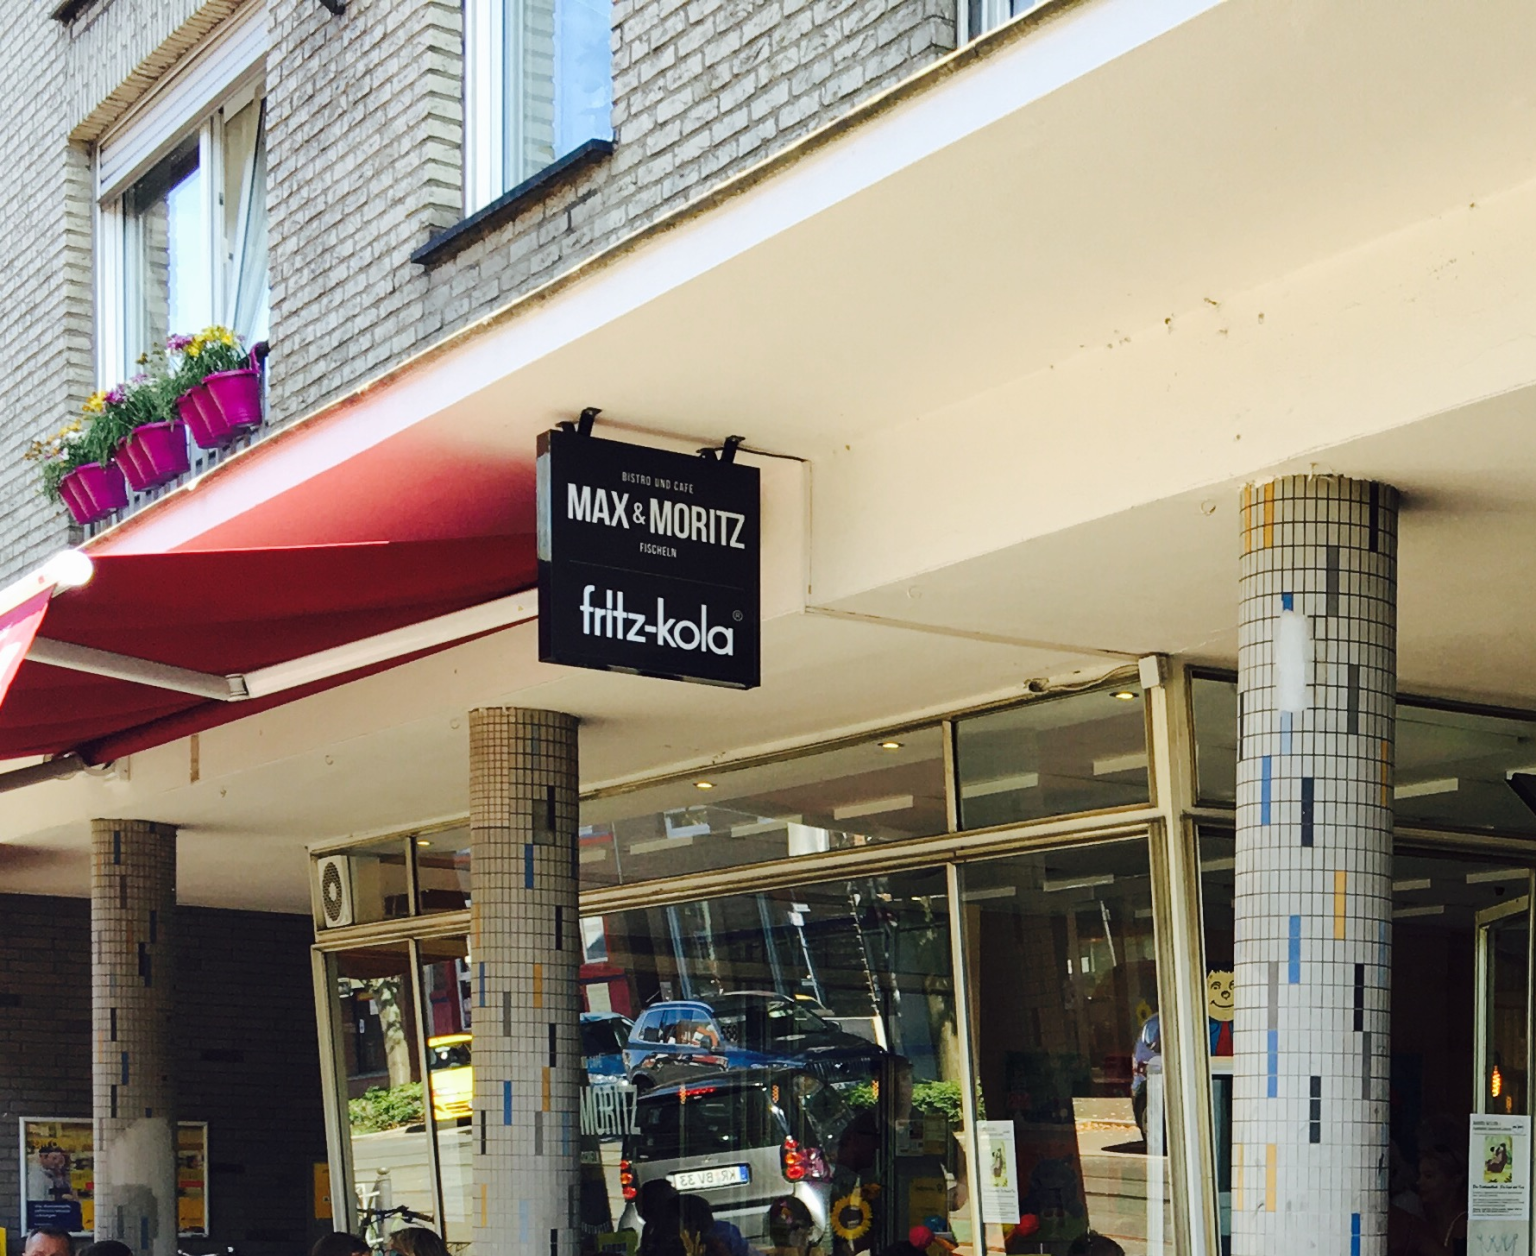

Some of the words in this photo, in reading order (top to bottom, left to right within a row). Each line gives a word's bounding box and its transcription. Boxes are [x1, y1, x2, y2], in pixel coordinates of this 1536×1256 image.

[622, 471, 651, 486] BISTRO
[654, 478, 671, 490] UND
[674, 481, 694, 495] CAFE
[567, 482, 630, 530] MAX
[632, 502, 646, 525] &
[650, 498, 746, 550] MORITZ
[640, 542, 677, 558] FISCHELN
[580, 1084, 642, 1136] MORITZ
